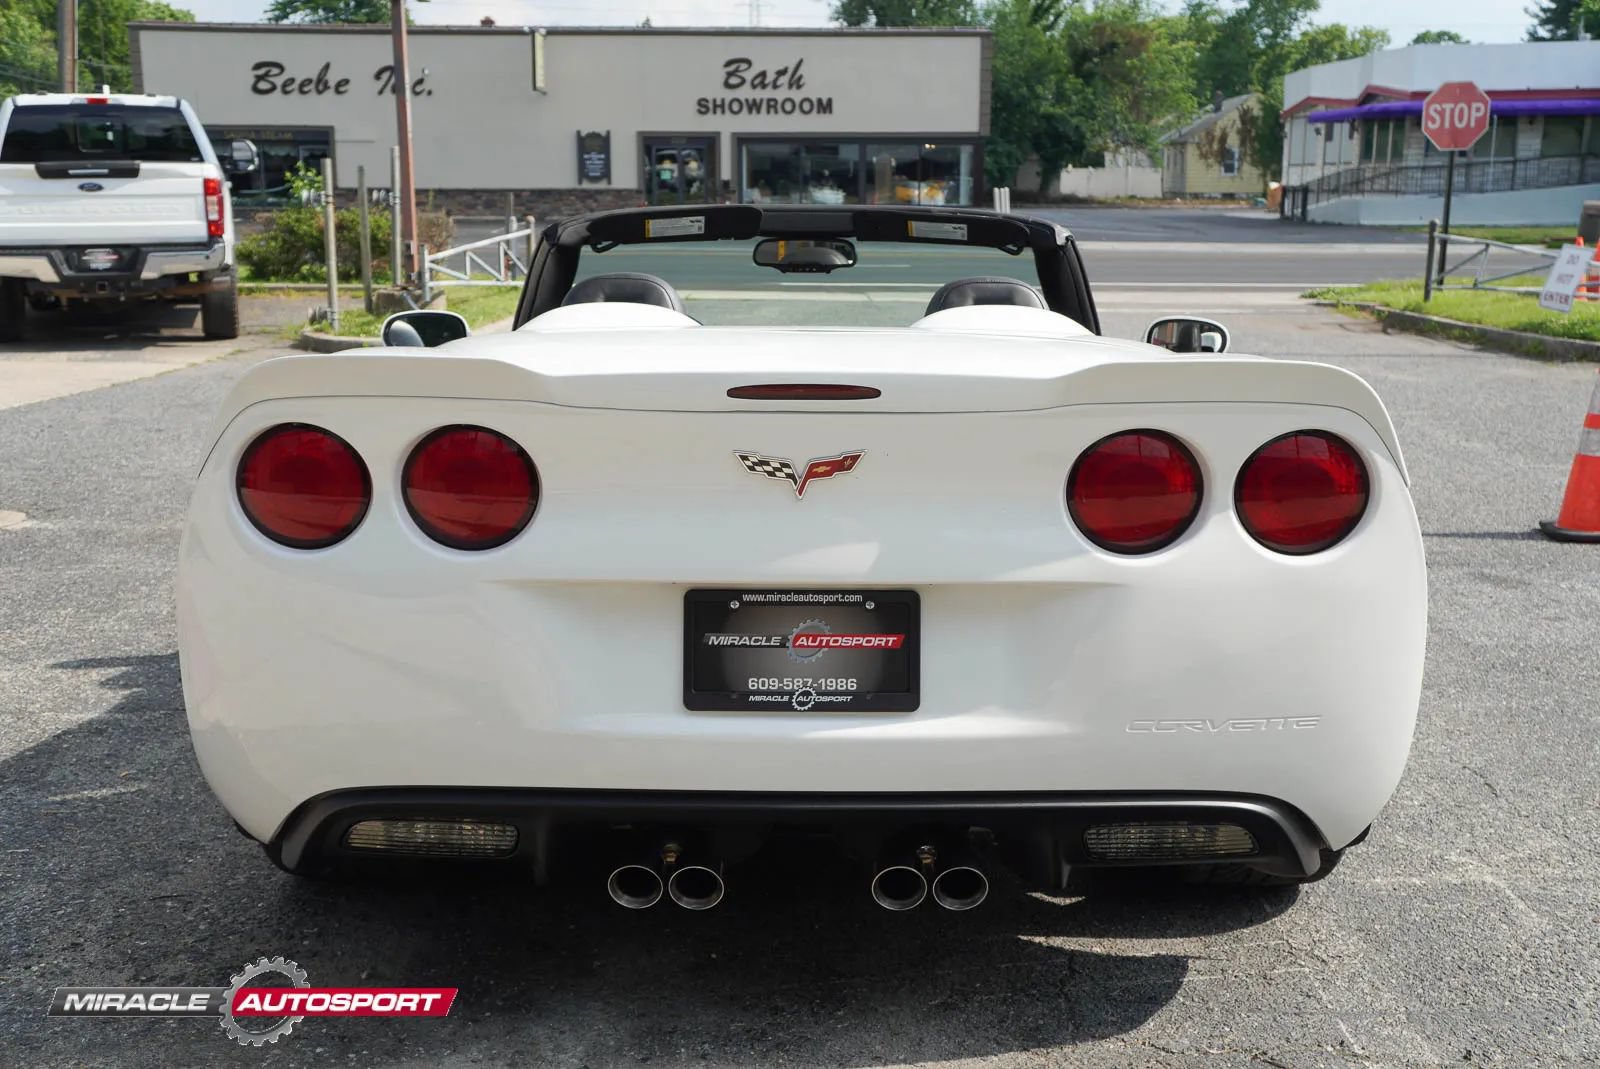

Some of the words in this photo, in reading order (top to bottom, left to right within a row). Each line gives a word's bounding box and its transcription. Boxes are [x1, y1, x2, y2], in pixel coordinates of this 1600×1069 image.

[251, 61, 351, 95] Beebe
[723, 57, 805, 90] Bath
[696, 97, 833, 115] SHOWROOM
[1427, 102, 1485, 129] STOP
[742, 592, 863, 604] www.miracleautosport.com
[708, 635, 782, 646] MIRACLE
[794, 636, 898, 647] AUTOSPORT
[748, 678, 857, 690] 609-587-1986
[748, 695, 789, 703] MIRACLE
[795, 695, 853, 703] AUTOSPORT
